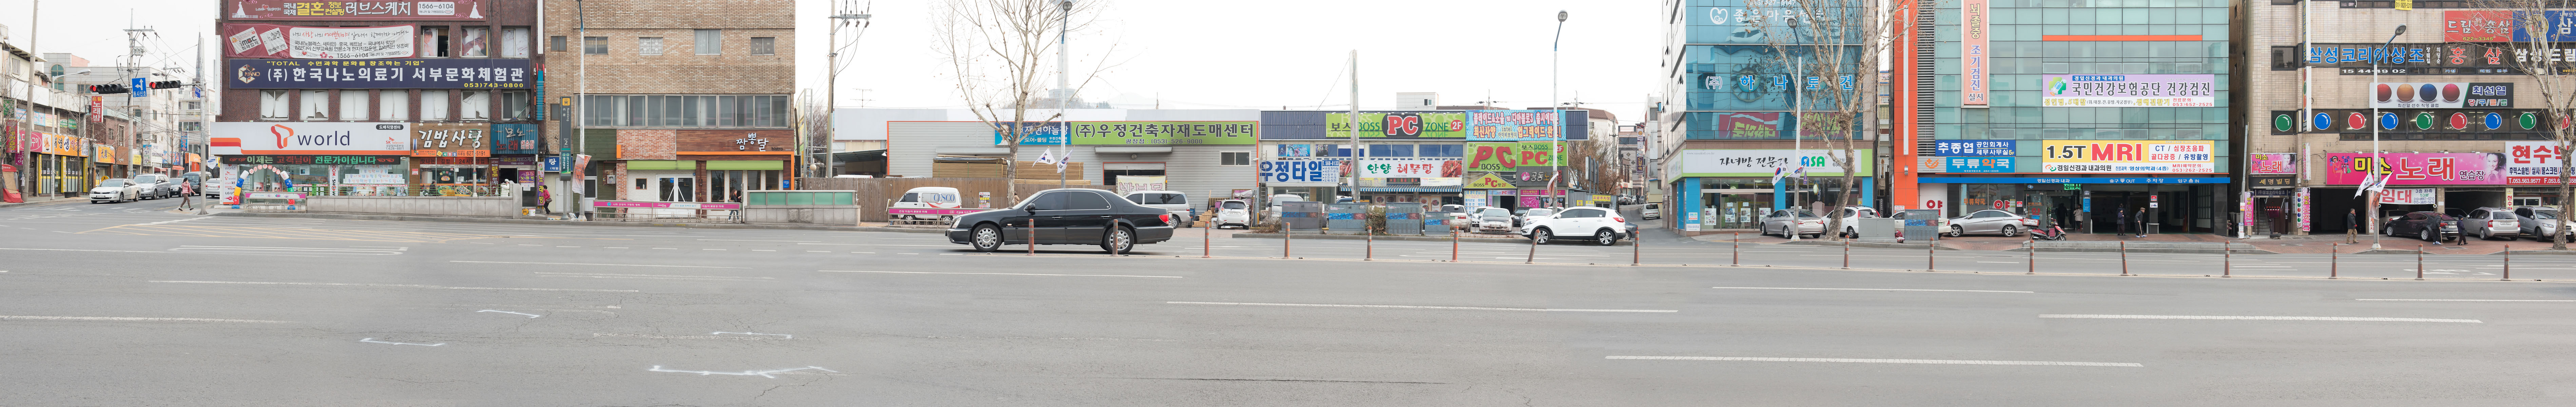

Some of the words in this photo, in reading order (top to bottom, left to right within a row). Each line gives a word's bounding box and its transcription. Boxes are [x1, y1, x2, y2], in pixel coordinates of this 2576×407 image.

[297, 2, 324, 16] 결혼
[346, 2, 411, 16] 러브스케치
[1970, 4, 1981, 39] 뇌졸중
[2446, 20, 2472, 34] 드림
[2484, 20, 2511, 34] 홍삼
[2309, 47, 2425, 63] 삼성코리아상조
[2449, 47, 2502, 64] 홍삼
[293, 67, 403, 82] 한국나노의료기
[412, 67, 524, 81] 서부문화체험관
[1970, 45, 1981, 91] 조기검진
[2072, 82, 2161, 96] 국민건강보험공단
[2167, 82, 2210, 96] 건강검진
[2473, 86, 2506, 96] 최선열
[1968, 93, 1983, 101] 실시
[93, 101, 101, 122] 노래방
[1473, 112, 1505, 124] 블레이드&소울
[1511, 112, 1533, 124] 디아블로3
[505, 128, 525, 137] 모노
[1388, 116, 1418, 135] PC
[1425, 122, 1449, 131] ZONE
[1452, 121, 1461, 130] 2F
[1473, 126, 1496, 138] 최신사양
[1518, 125, 1546, 138] 업그레이드
[298, 131, 350, 146] world
[419, 130, 482, 148] 김밥사랑
[496, 140, 518, 150] 노래
[521, 140, 534, 149] 연습장
[736, 133, 769, 151] 짬뽕달
[1938, 142, 1974, 154] 추종엽
[2047, 145, 2086, 159] 1.5T
[2092, 143, 2142, 161] MRI
[247, 156, 273, 164] 이제는
[277, 156, 311, 164] 고객님이
[315, 156, 376, 164] 전문가이십니다
[1469, 146, 1515, 168] PC
[1521, 151, 1548, 165] PC
[1720, 157, 1752, 168] 자녀방
[1952, 159, 2009, 168] 두류약국
[1260, 161, 1322, 182] 우정타일
[1368, 163, 1391, 174] 안양
[1397, 163, 1433, 174] 해물탕
[2261, 160, 2283, 173] 노래
[2397, 157, 2455, 181] 노래
[2459, 170, 2485, 181] 연습장
[1485, 178, 1497, 187] PC
[2304, 196, 2309, 205] 미소
[2381, 189, 2412, 203] 임대
[2246, 206, 2252, 219] 노래
[2304, 206, 2309, 221] 노래
